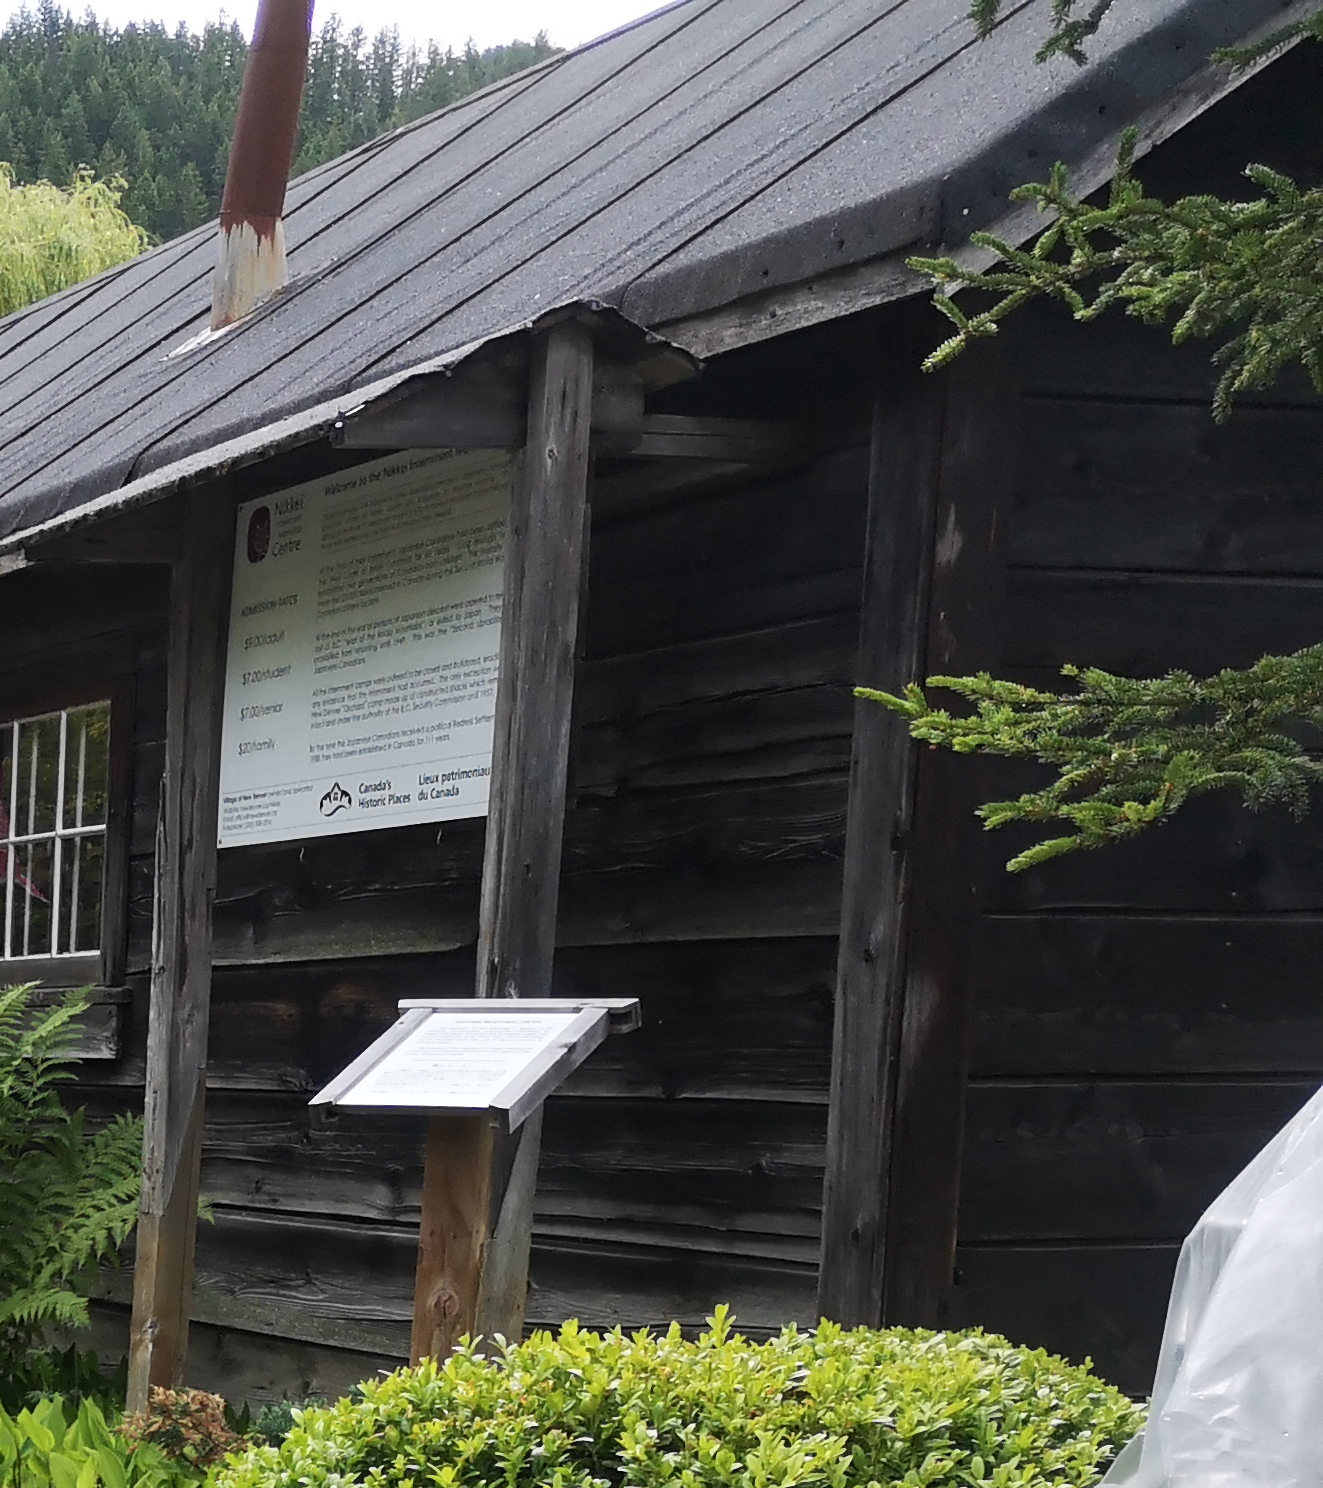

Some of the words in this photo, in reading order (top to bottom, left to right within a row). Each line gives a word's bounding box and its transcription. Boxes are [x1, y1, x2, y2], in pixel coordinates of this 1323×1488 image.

[274, 493, 305, 517] Nikkei
[272, 539, 301, 557] Centre
[418, 773, 439, 786] Lieux
[440, 765, 491, 785] patrimoniau
[358, 780, 392, 795] Canada's
[417, 790, 428, 801] du
[430, 784, 460, 800] Canada
[358, 795, 386, 809] Historic
[387, 792, 411, 806] Places
